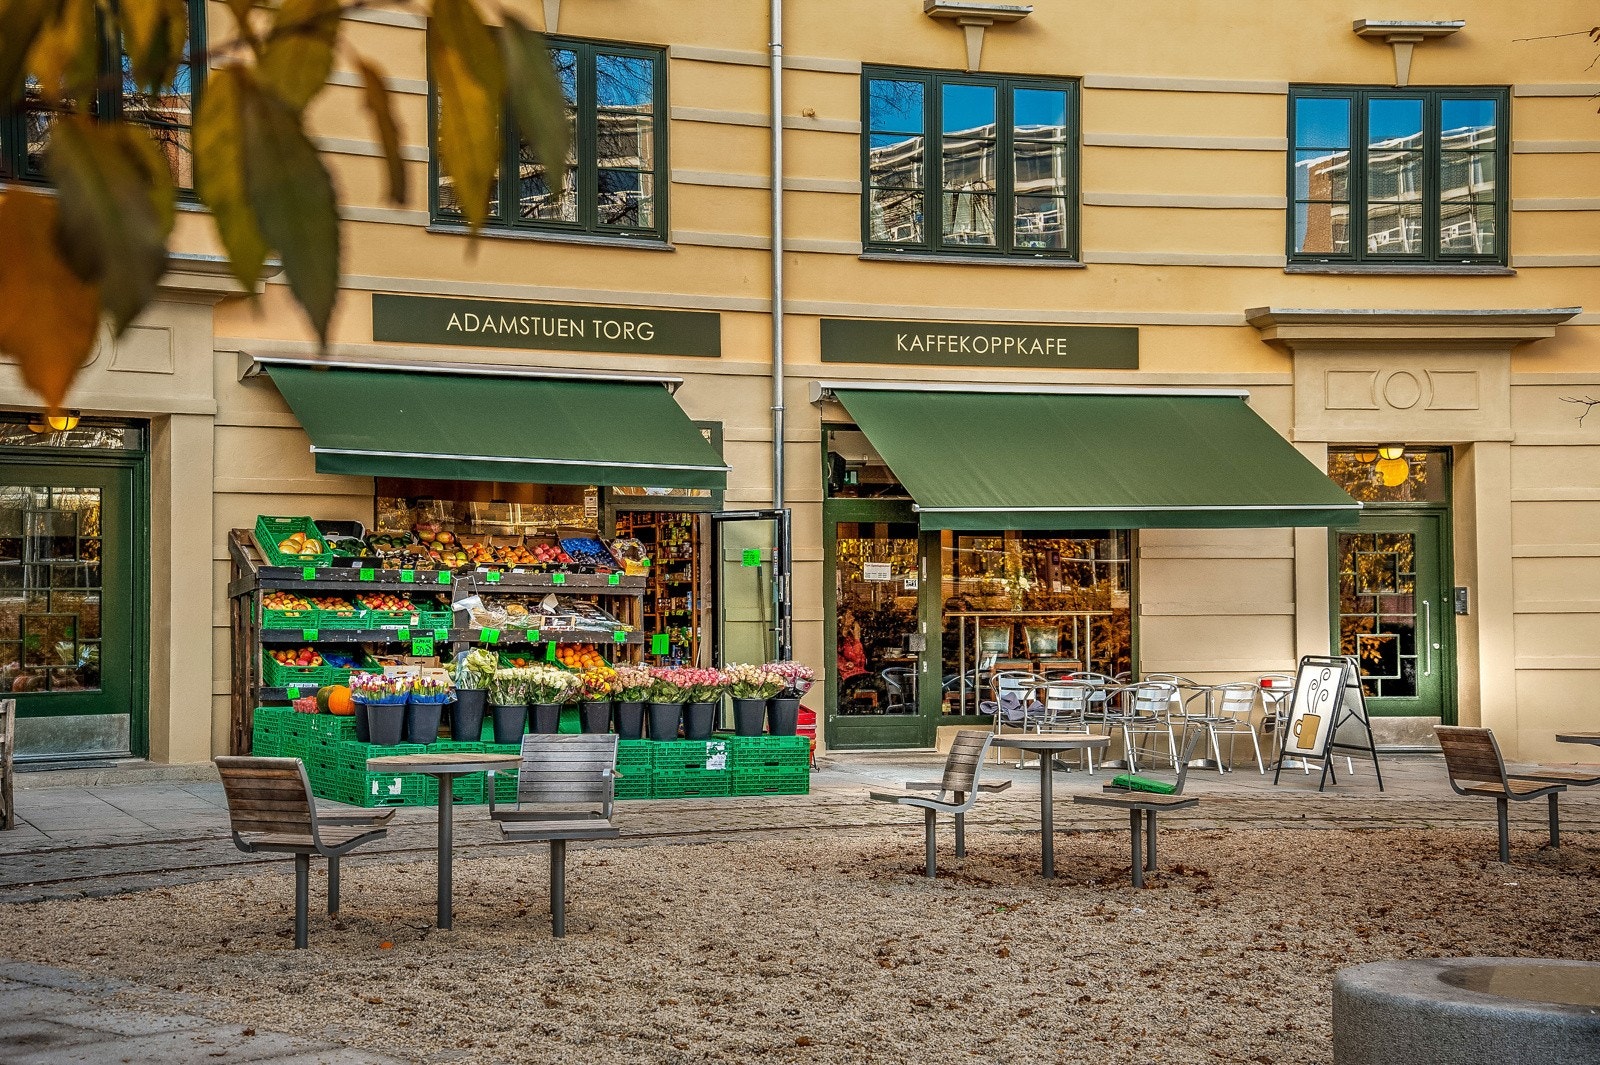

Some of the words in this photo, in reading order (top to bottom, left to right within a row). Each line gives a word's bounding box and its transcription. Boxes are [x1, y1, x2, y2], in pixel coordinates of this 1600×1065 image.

[446, 313, 584, 338] ADAMSTUEN
[593, 320, 655, 341] TORG
[897, 333, 1067, 355] KAFFEKOPPKAFE
